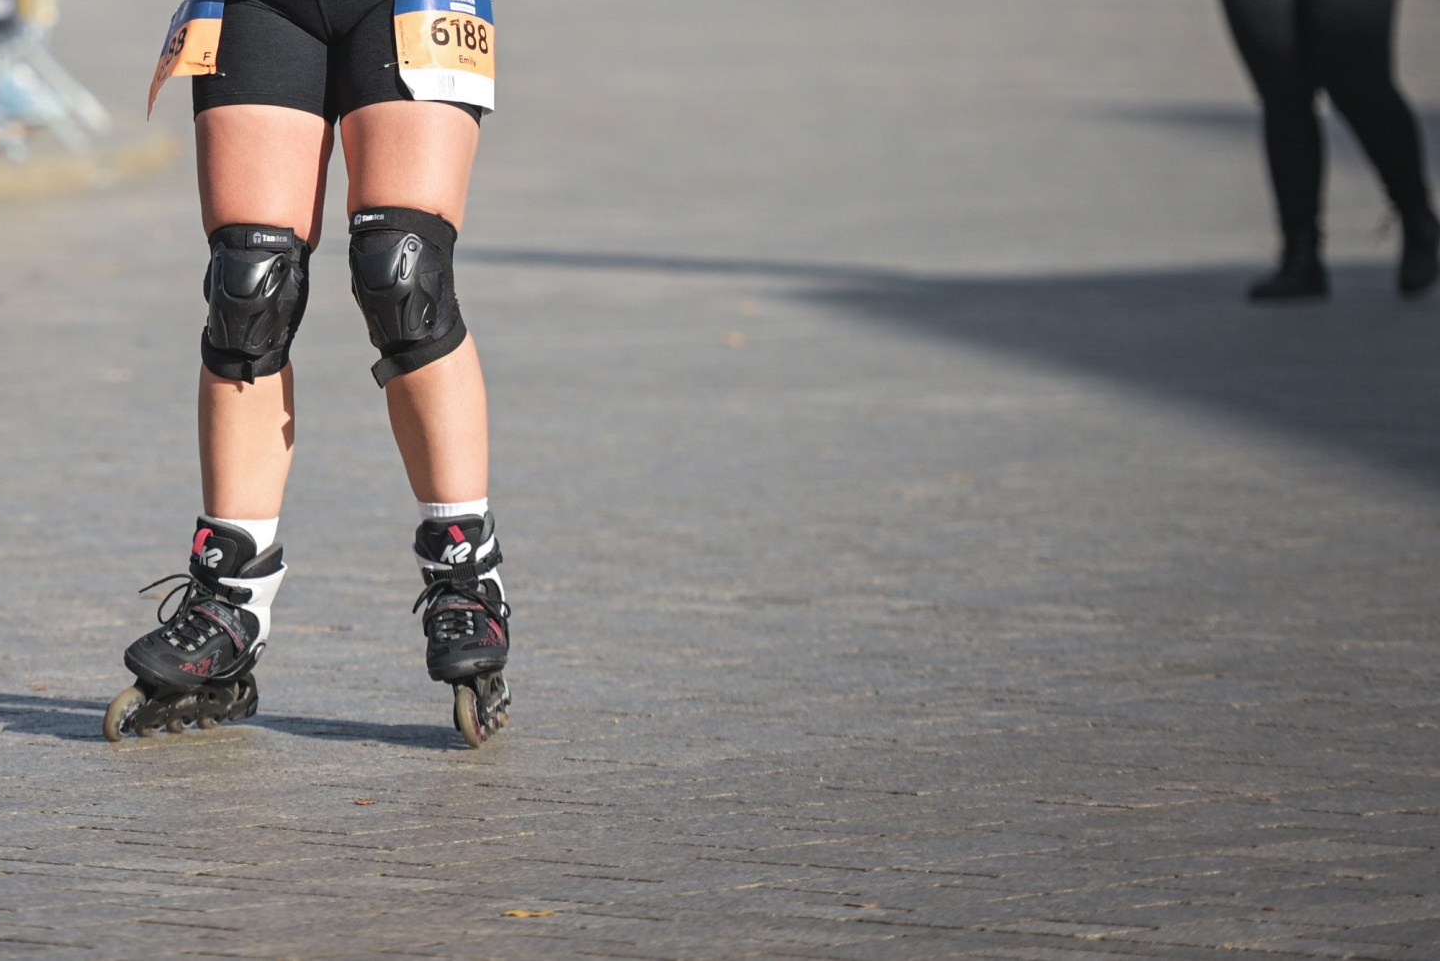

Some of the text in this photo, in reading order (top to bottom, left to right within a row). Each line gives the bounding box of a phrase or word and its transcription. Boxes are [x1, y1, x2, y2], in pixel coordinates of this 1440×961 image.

[431, 17, 489, 55] 6188
[203, 51, 212, 61] F
[459, 54, 477, 68] Emily
[199, 546, 223, 568] K2
[440, 541, 472, 564] K2
